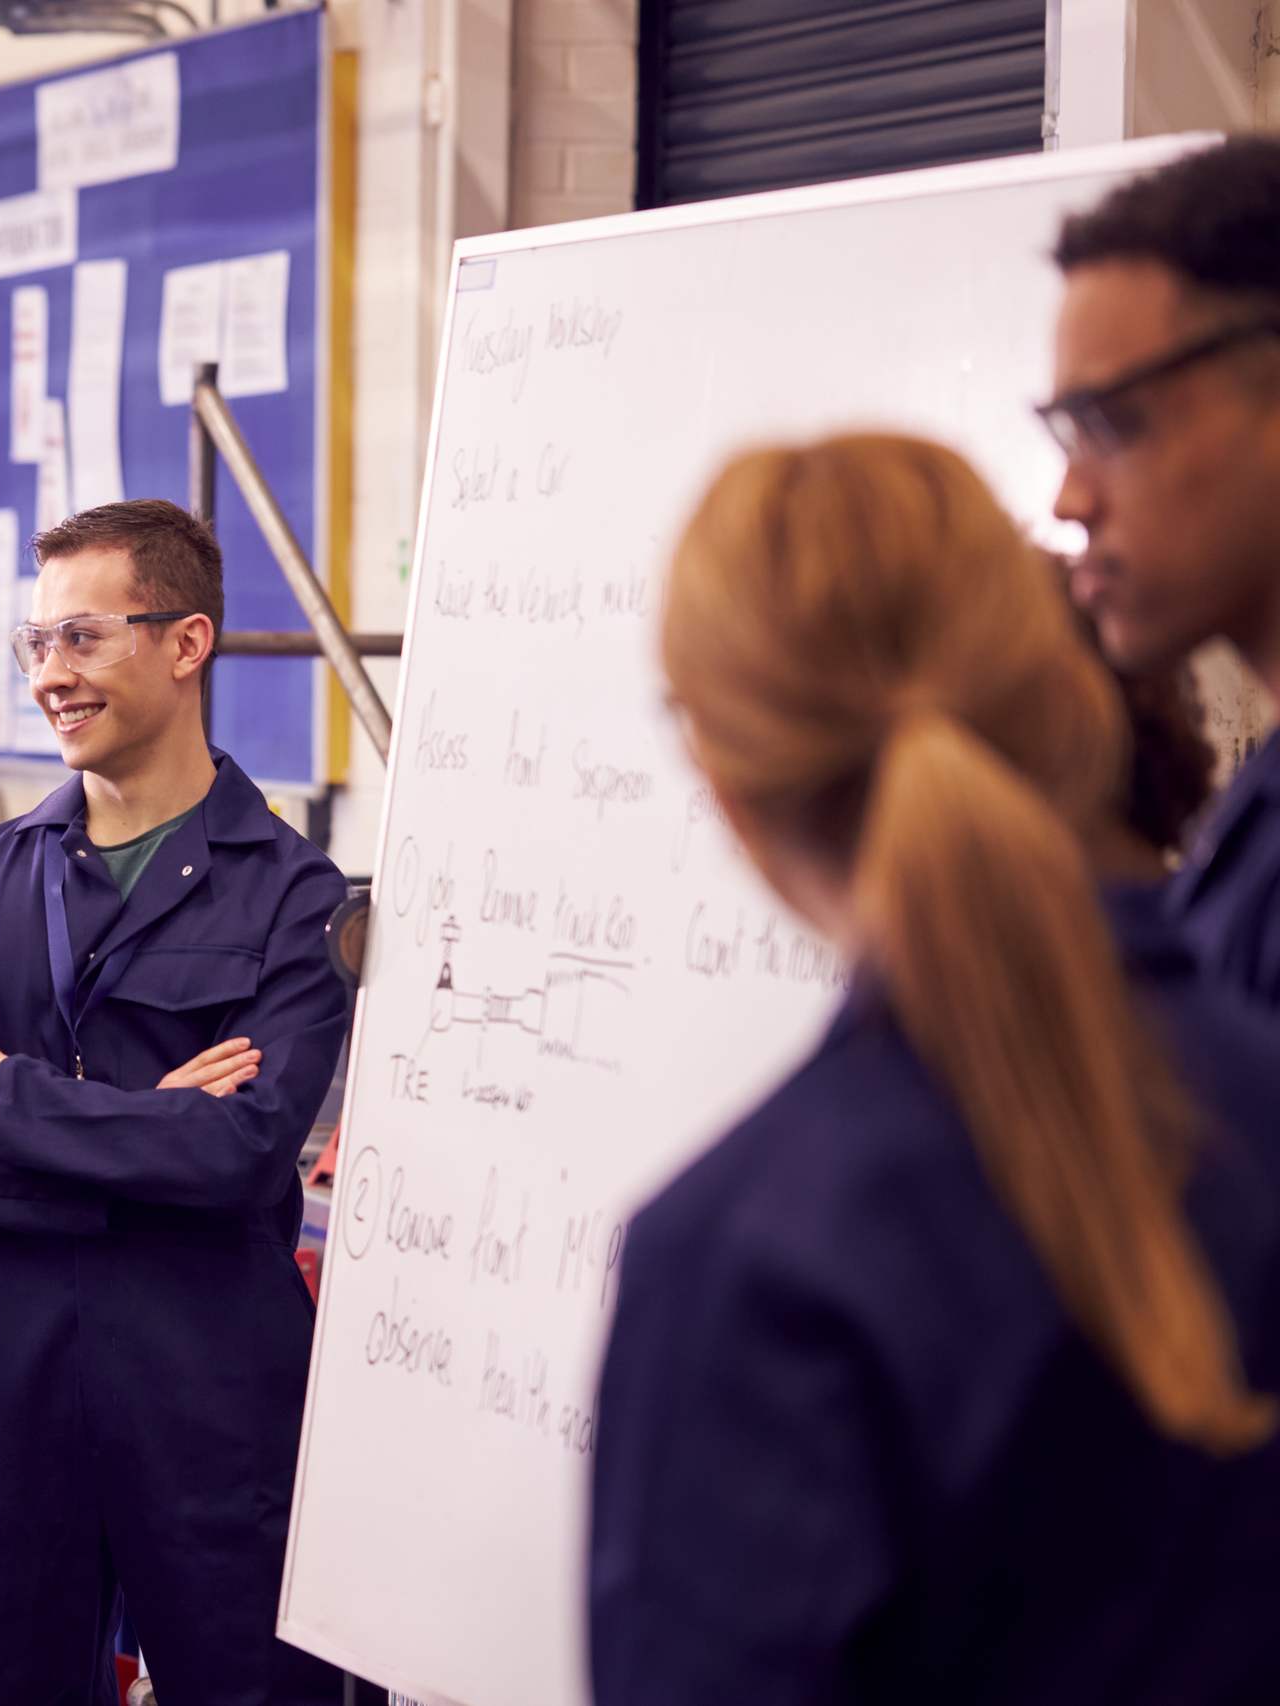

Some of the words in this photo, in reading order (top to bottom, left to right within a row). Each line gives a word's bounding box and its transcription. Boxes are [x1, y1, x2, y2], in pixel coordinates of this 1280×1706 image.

[505, 466, 520, 502] a
[389, 1052, 431, 1104] TRE
[386, 1163, 455, 1263] Remove
